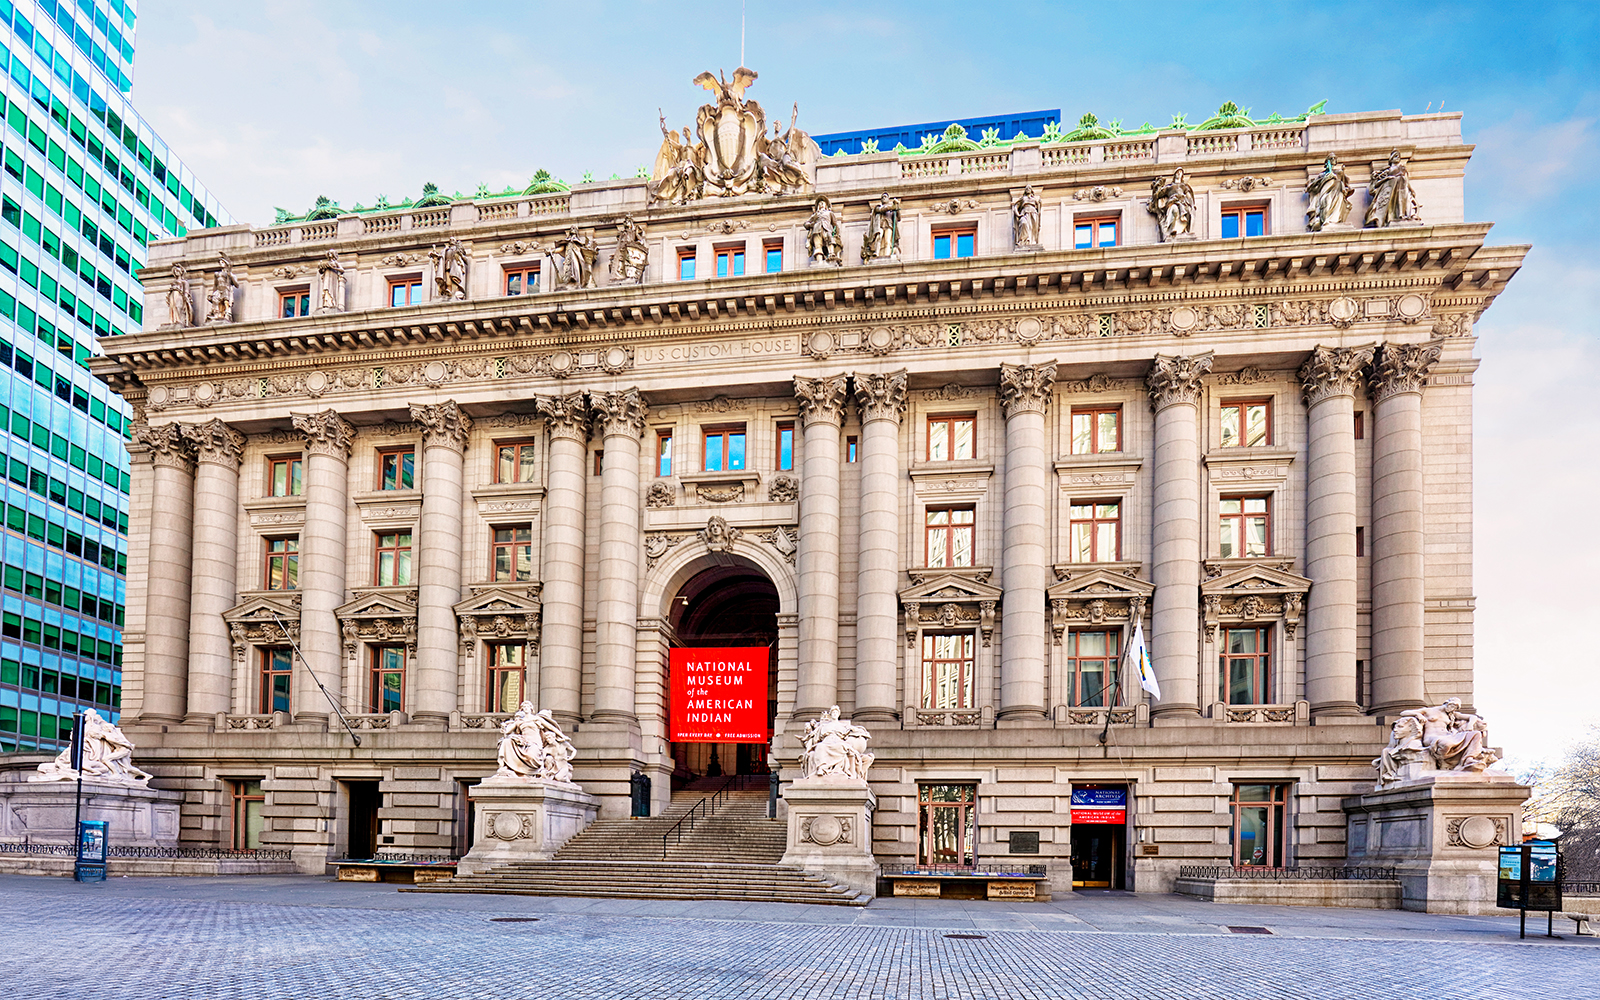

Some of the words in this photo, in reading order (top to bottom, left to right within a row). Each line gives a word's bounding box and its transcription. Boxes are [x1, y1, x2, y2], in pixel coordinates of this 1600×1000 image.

[671, 344, 733, 360] CUSTOM
[740, 340, 792, 355] HOUSE
[686, 661, 752, 672] NATIONAL
[686, 675, 743, 686] MUSEUM
[686, 687, 695, 698] of
[696, 687, 708, 696] the
[686, 699, 753, 710] AMERICAN
[686, 712, 732, 723] INDIAN
